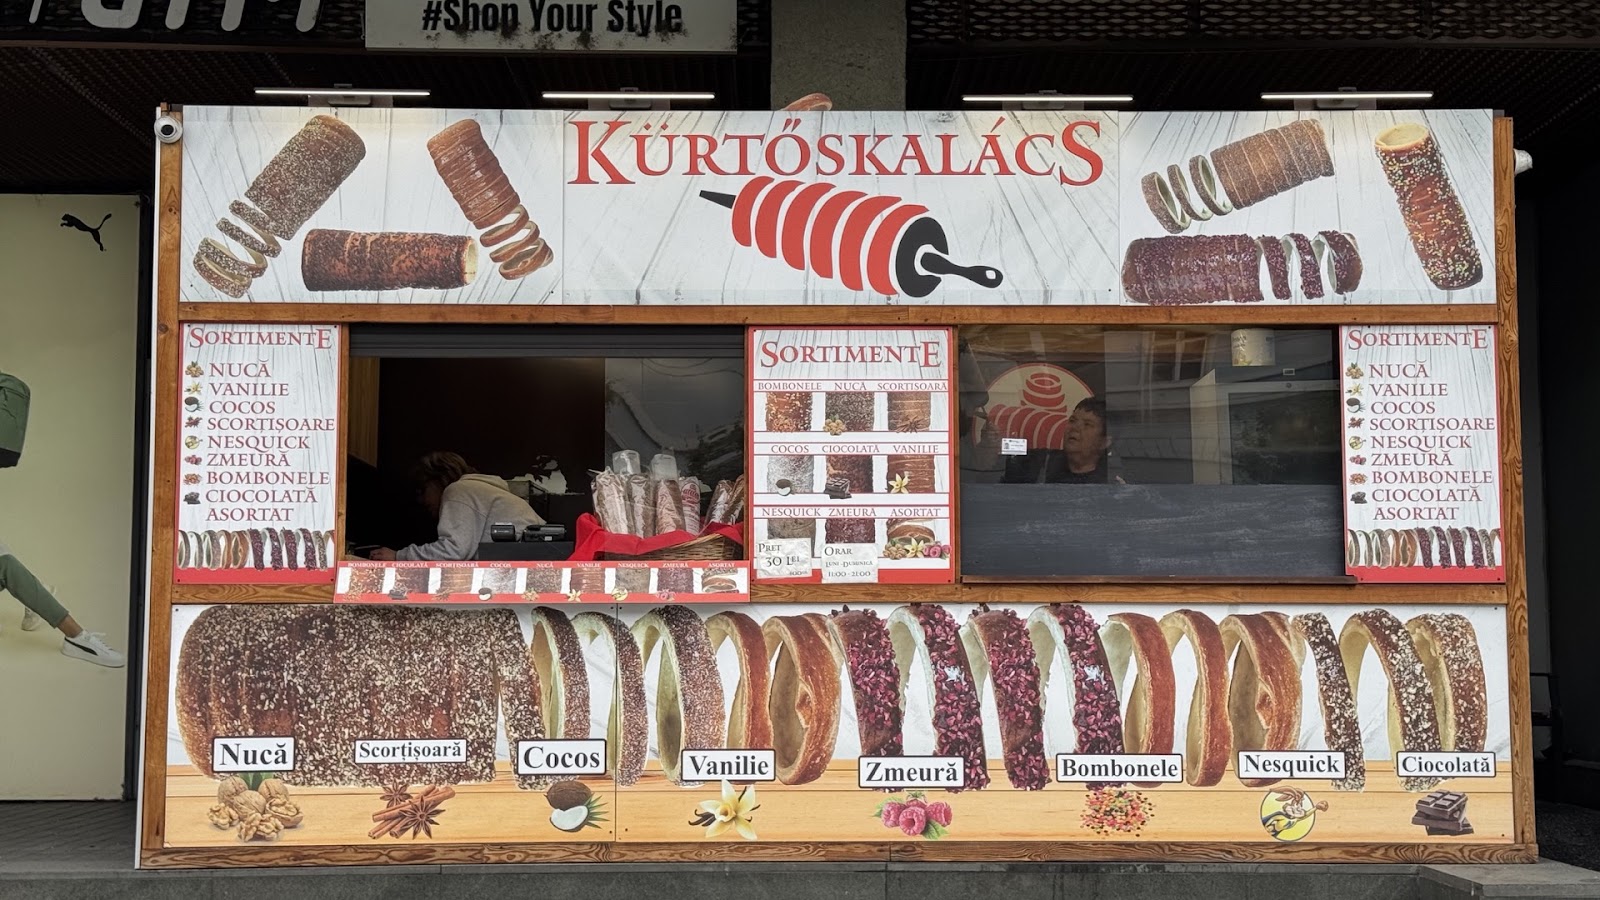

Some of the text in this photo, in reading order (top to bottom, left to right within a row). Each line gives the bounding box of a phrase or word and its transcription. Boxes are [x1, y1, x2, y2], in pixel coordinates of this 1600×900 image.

[421, 0, 683, 38] #Shop Your Style
[567, 117, 1102, 187] KÜRTŐSKALÁCS
[189, 328, 332, 350] SORTIMENTE
[1348, 329, 1488, 350] SORTIMENTE
[760, 341, 942, 368] SORTIMENTE
[209, 358, 271, 377] NUCĂ
[1369, 359, 1429, 378] NUCĂ
[209, 382, 290, 396] VANILIE
[758, 382, 822, 390] BOMBONELE
[1369, 383, 1448, 396] VANILIE
[209, 401, 276, 414] COCOS
[1371, 401, 1436, 414] COCOS
[206, 435, 311, 452] NESQUICK
[771, 444, 810, 454] COCOS
[893, 444, 939, 454] VANILIE
[1370, 435, 1472, 452] NESQUICK
[206, 450, 291, 467] ZMEURĂ
[1371, 450, 1453, 466] ZMEURĂ
[205, 471, 330, 485] BOMBONELE
[1372, 471, 1493, 484] BOMBONELE
[205, 486, 318, 503] CIOCOLATĂ
[1372, 485, 1483, 502] CIOCOLATĂ
[205, 507, 294, 521] ASORTAT
[761, 507, 822, 518] NESQUICK
[890, 508, 942, 517] ASORTAT
[1373, 507, 1460, 521] ASORTAT
[824, 546, 853, 556] ORAR
[765, 556, 782, 567] 30
[220, 743, 288, 766] Nucă
[359, 741, 462, 761] Scorțișoară
[523, 746, 600, 769] Cocos
[689, 755, 769, 776] Vanilie
[866, 761, 958, 782] Zmeură
[1061, 759, 1179, 777] Bombonele
[1244, 754, 1341, 777] Nesquick
[1402, 756, 1491, 773] Ciocolată
